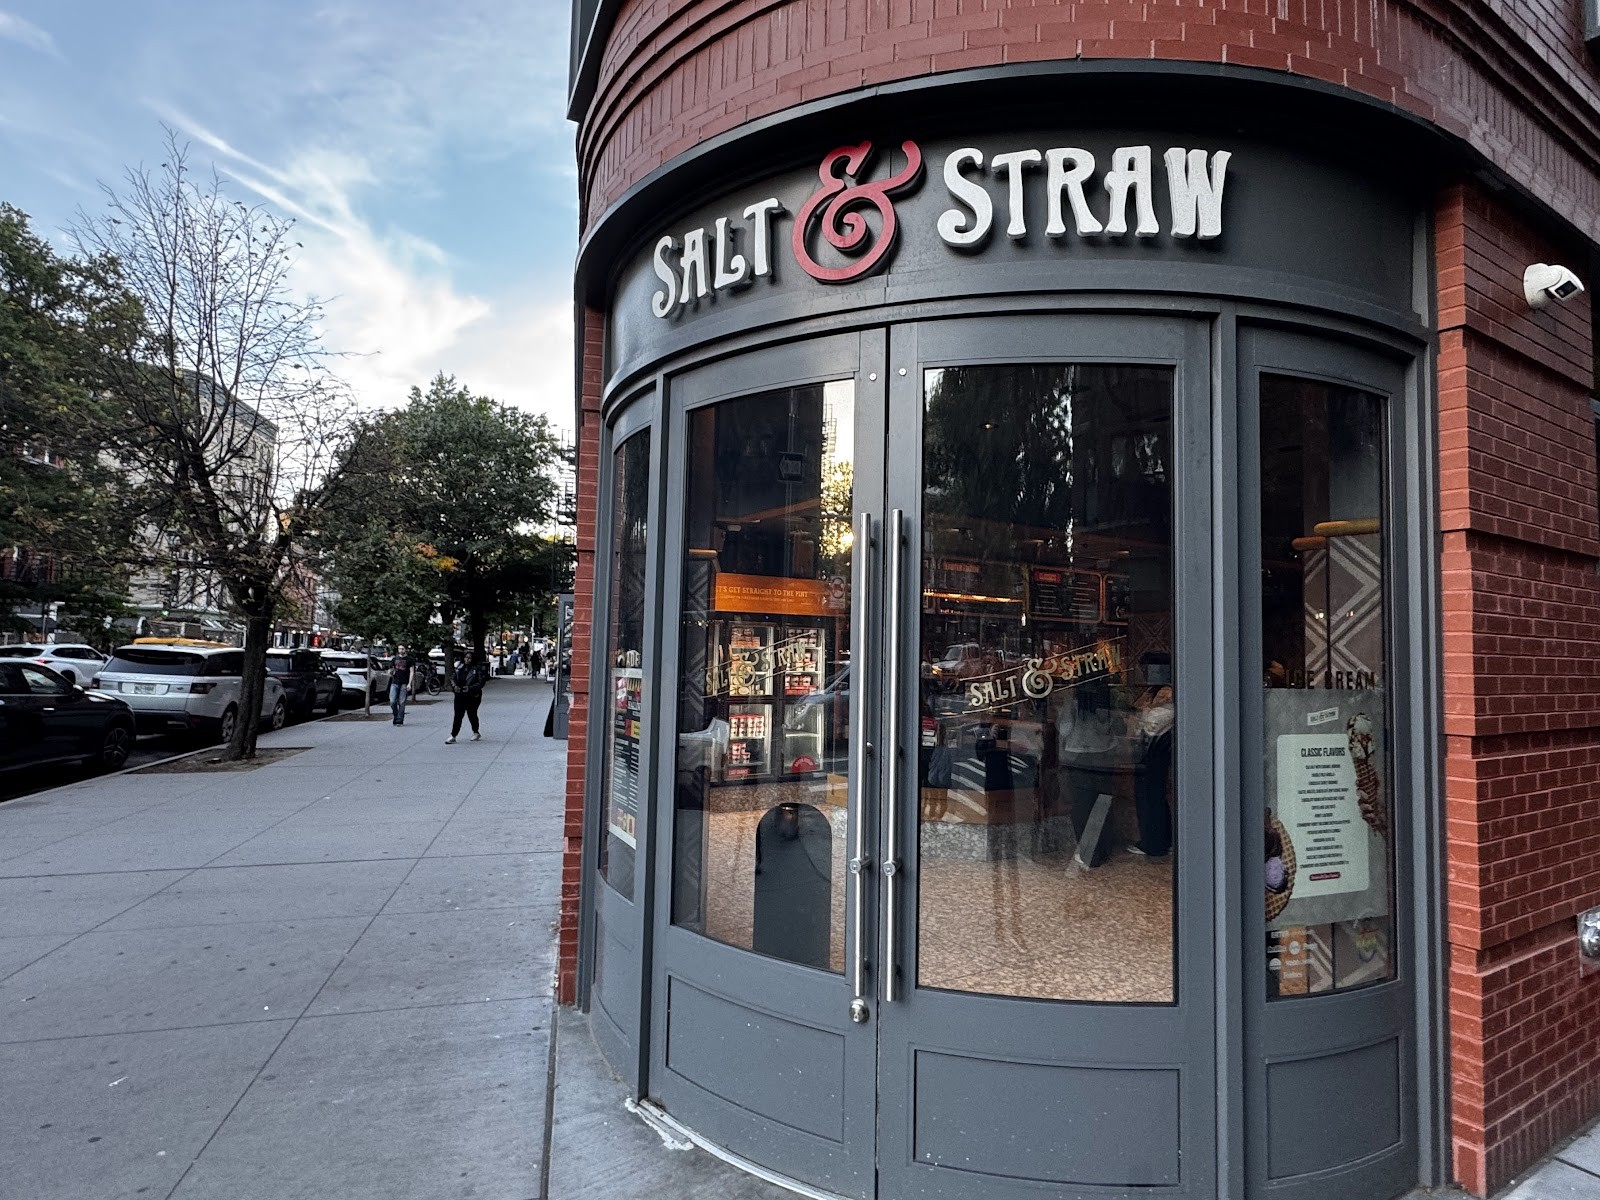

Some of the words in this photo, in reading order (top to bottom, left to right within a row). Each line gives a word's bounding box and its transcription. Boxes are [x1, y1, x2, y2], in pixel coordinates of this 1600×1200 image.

[651, 197, 783, 319] SALT
[792, 139, 925, 284] &
[937, 145, 1232, 248] STRAW
[728, 586, 741, 594] GET
[774, 588, 782, 596] TO
[783, 589, 794, 597] THE
[969, 675, 1017, 706] SALT
[1021, 657, 1058, 699] &
[1060, 643, 1122, 681] STRAW
[1300, 747, 1323, 757] CLASSIC
[1323, 747, 1346, 757] FLAVORS
